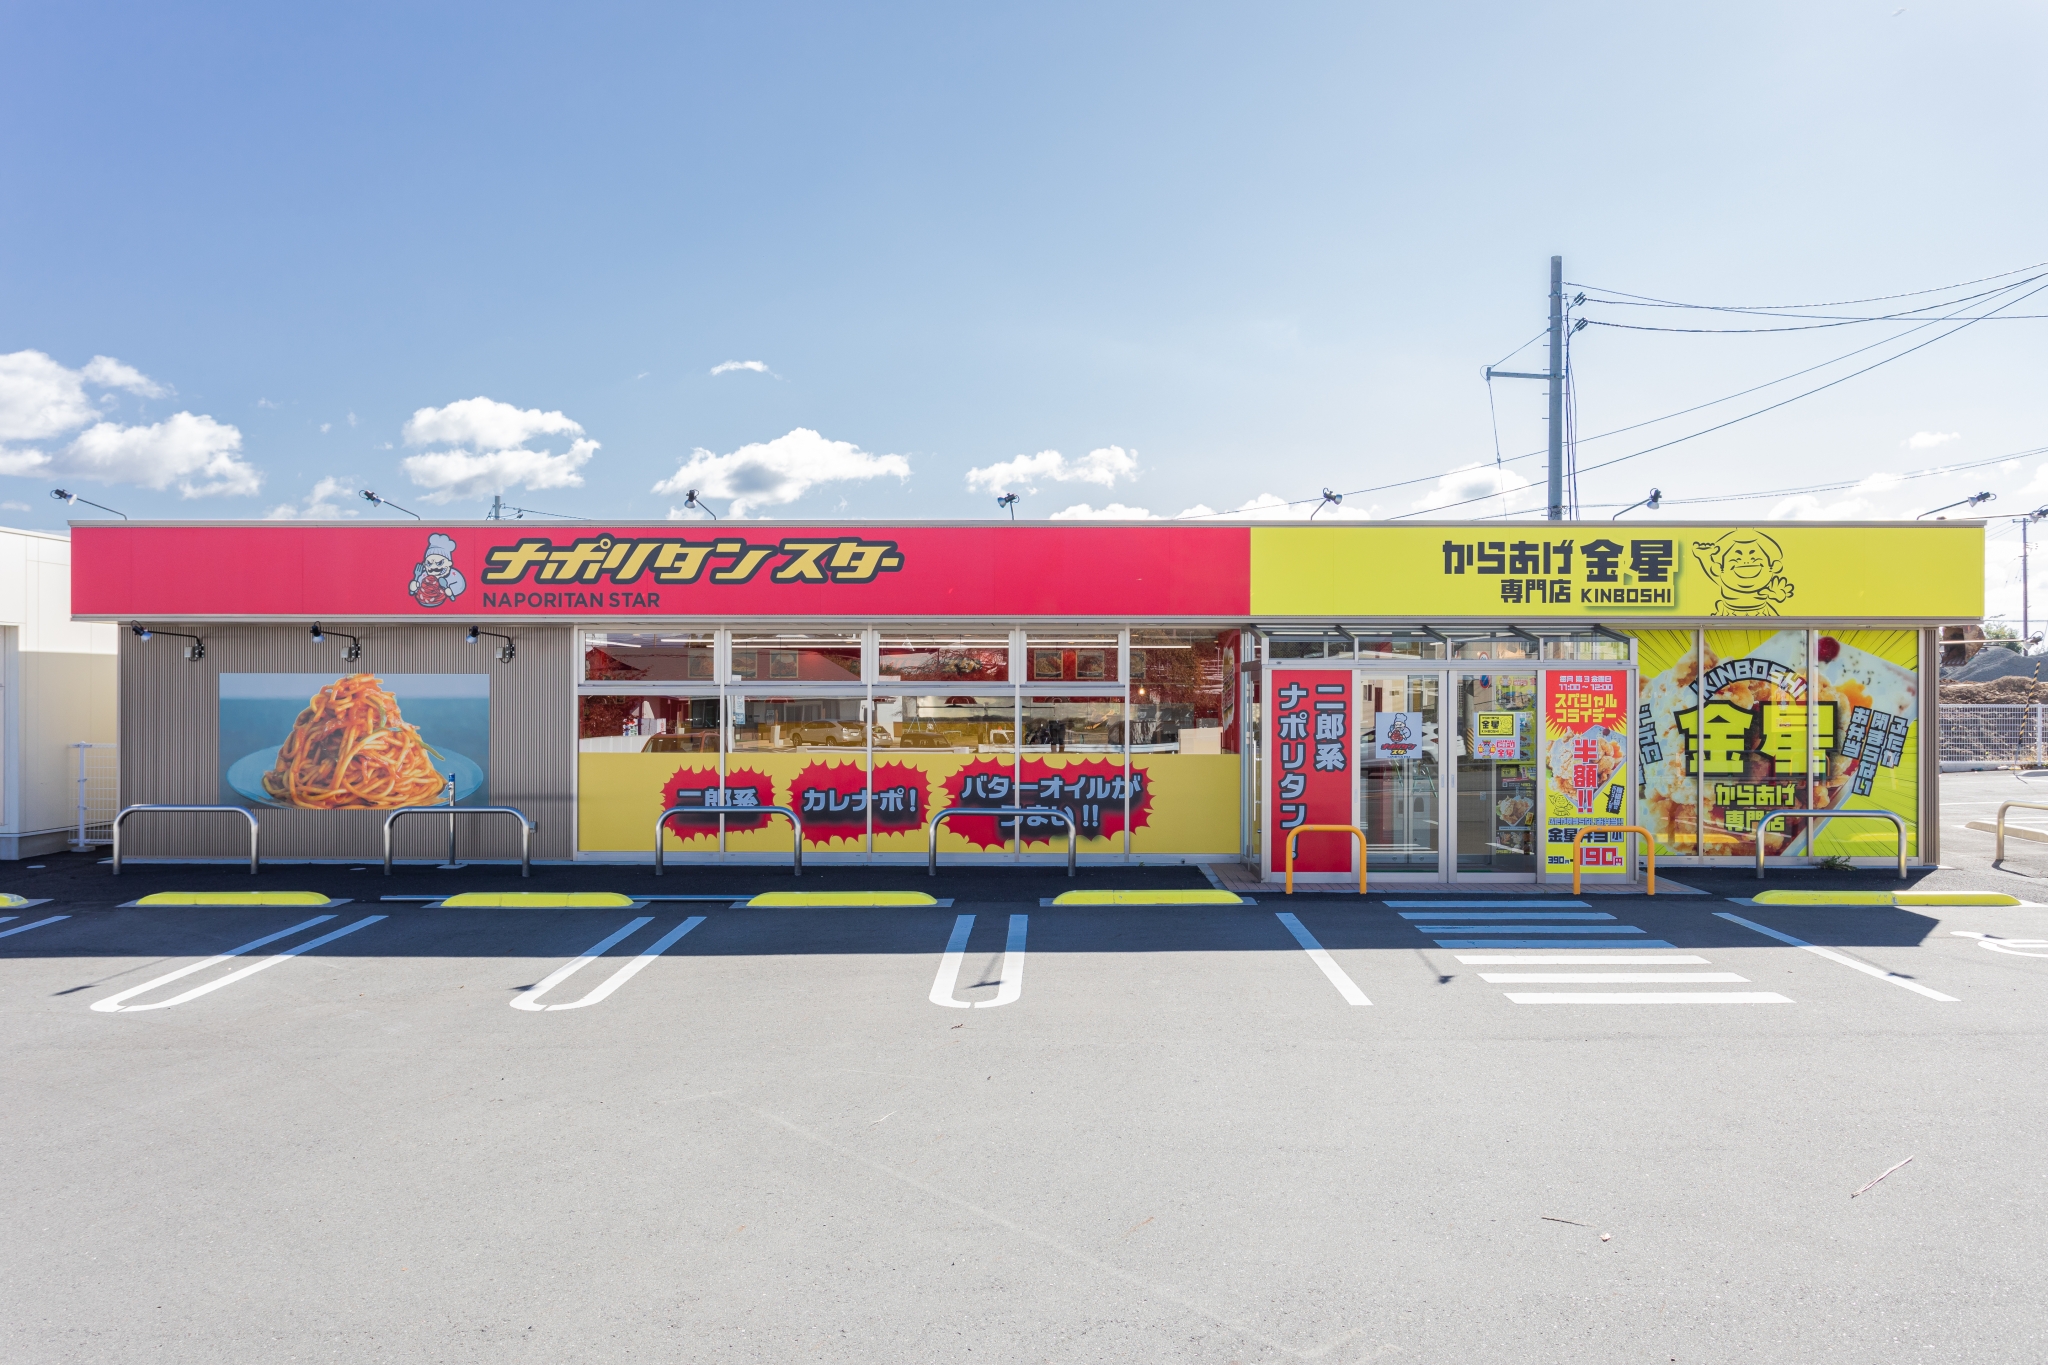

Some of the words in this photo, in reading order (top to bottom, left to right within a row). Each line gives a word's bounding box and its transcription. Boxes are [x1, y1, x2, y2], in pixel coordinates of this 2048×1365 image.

[1443, 540, 1574, 574] からあげ
[1580, 539, 1673, 582] 金星
[483, 592, 604, 608] NAPORITAN
[609, 592, 660, 608] STAR
[1500, 579, 1572, 604] 専門店
[1581, 588, 1672, 603] KINBOSHI
[1690, 659, 1808, 699] KINBOSHI
[1555, 693, 1618, 708] スペシャル
[1316, 685, 1346, 771] 二郎系
[1676, 701, 1836, 776] 金星
[1841, 705, 1872, 760] お弁当
[1880, 716, 1909, 768] ふたが
[1852, 710, 1891, 797] 閉まらない
[961, 774, 1142, 800] バターオイルが
[1574, 739, 1598, 813] 半額!!
[1715, 783, 1797, 807] からあげ
